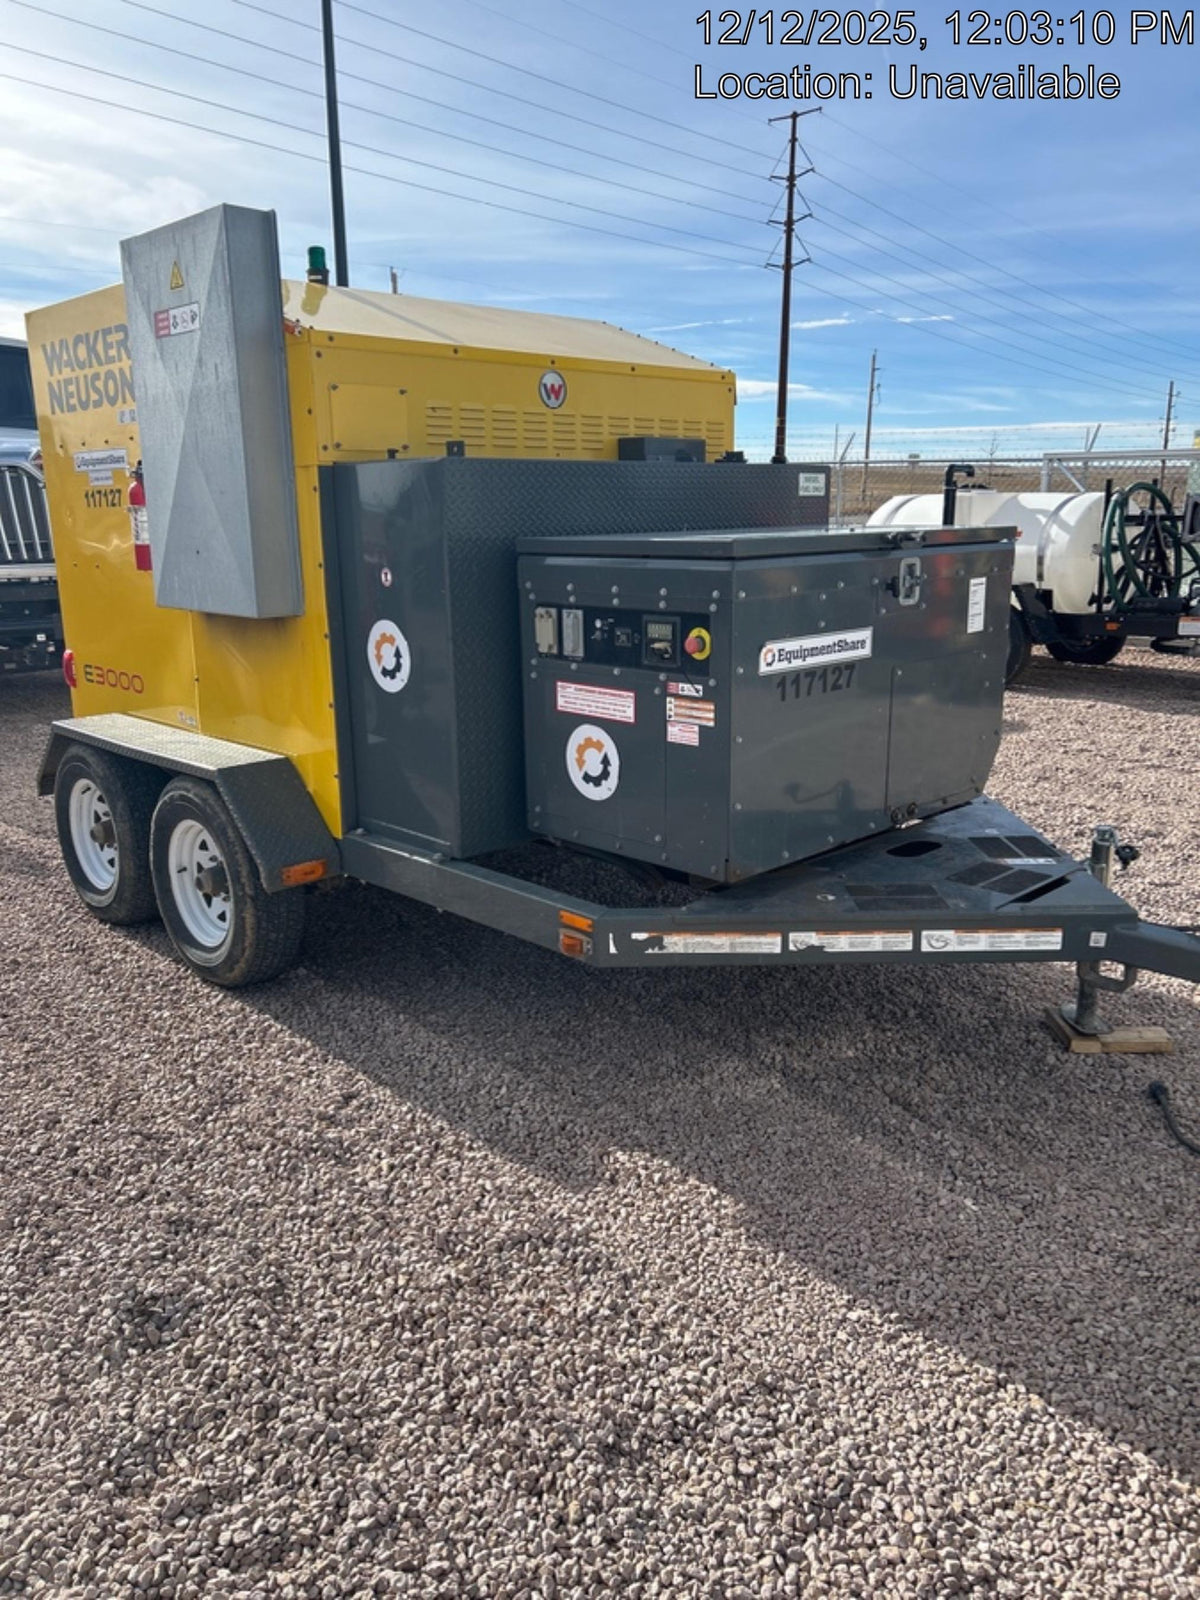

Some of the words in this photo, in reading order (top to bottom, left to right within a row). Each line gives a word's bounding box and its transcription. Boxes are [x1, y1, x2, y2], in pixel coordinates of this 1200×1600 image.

[41, 324, 131, 377] WACKER
[48, 366, 135, 415] NEUSON
[85, 488, 122, 508] 117127
[777, 638, 867, 665] EquipmentShare
[83, 663, 145, 695] E3000
[777, 663, 856, 702] 117127
